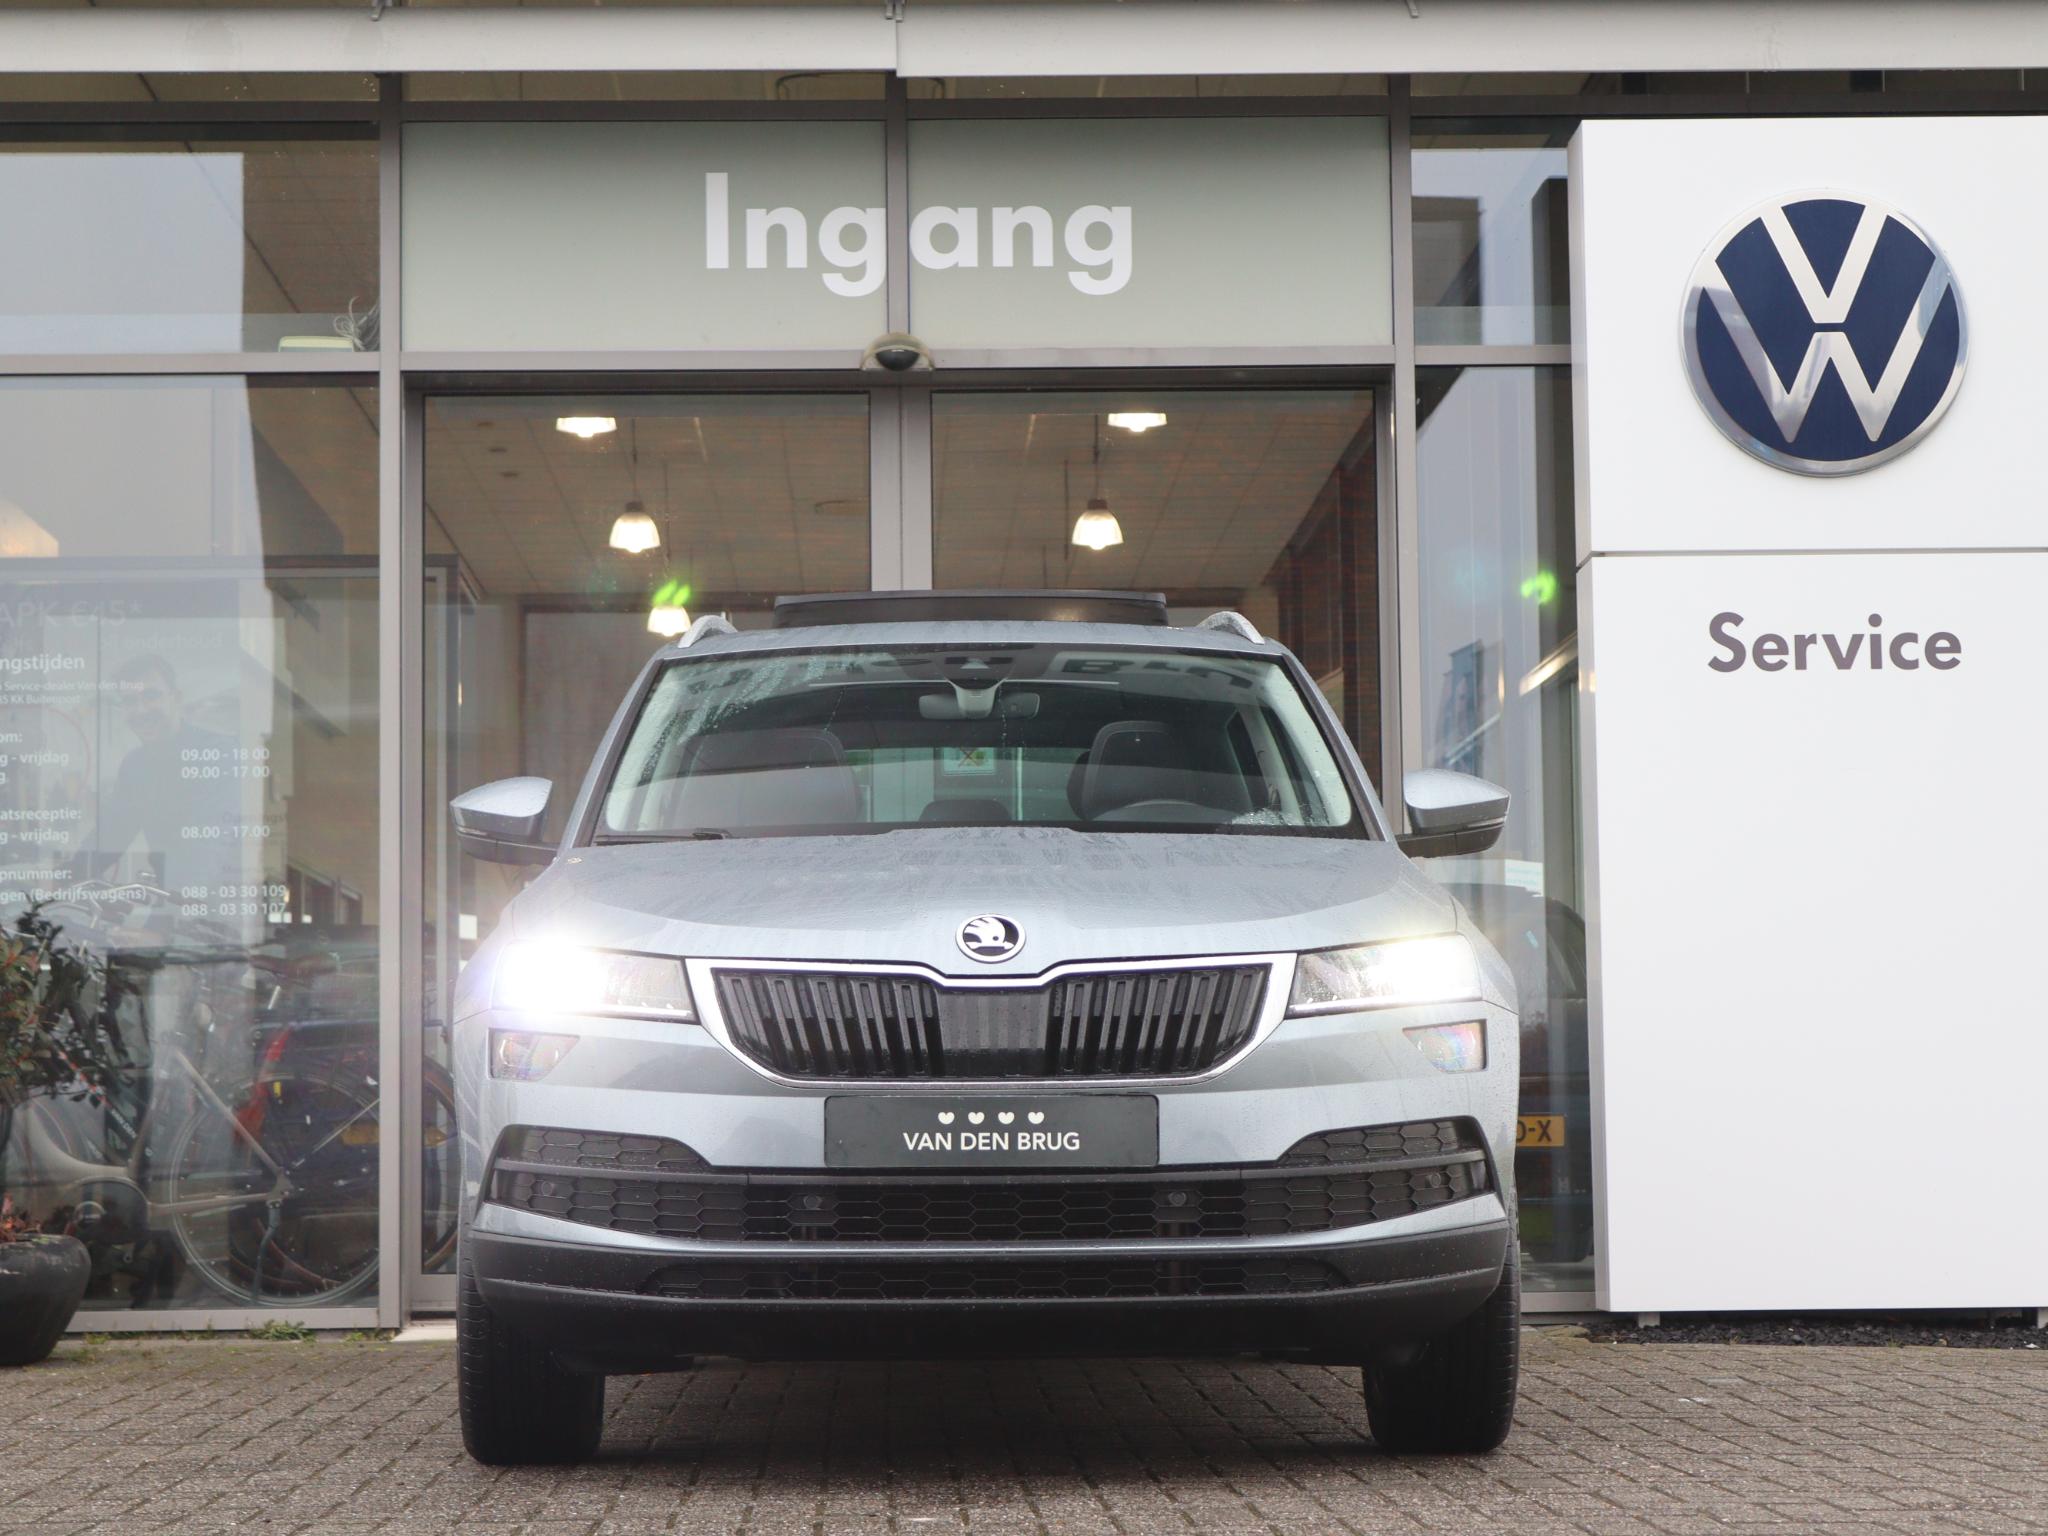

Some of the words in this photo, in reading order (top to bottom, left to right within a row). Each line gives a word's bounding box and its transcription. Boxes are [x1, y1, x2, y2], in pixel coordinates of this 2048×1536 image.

[705, 172, 1133, 296] Ingang
[1707, 612, 1962, 673] Service
[0, 653, 85, 674] ngstijden
[20, 750, 70, 768] vrijdag
[181, 748, 220, 761] 09.00
[181, 766, 220, 779] 09.00
[20, 828, 70, 845] vrijdag
[181, 825, 220, 839] 08.00
[232, 824, 270, 838] 17.00
[181, 885, 208, 899] 088
[219, 885, 237, 898] 03
[240, 884, 258, 898] 30
[181, 903, 208, 916] 088
[219, 903, 237, 916] 03
[240, 903, 258, 915] 30
[903, 1132, 953, 1151] VAN
[960, 1132, 1010, 1151] DEN
[1017, 1132, 1081, 1151] BRUG
